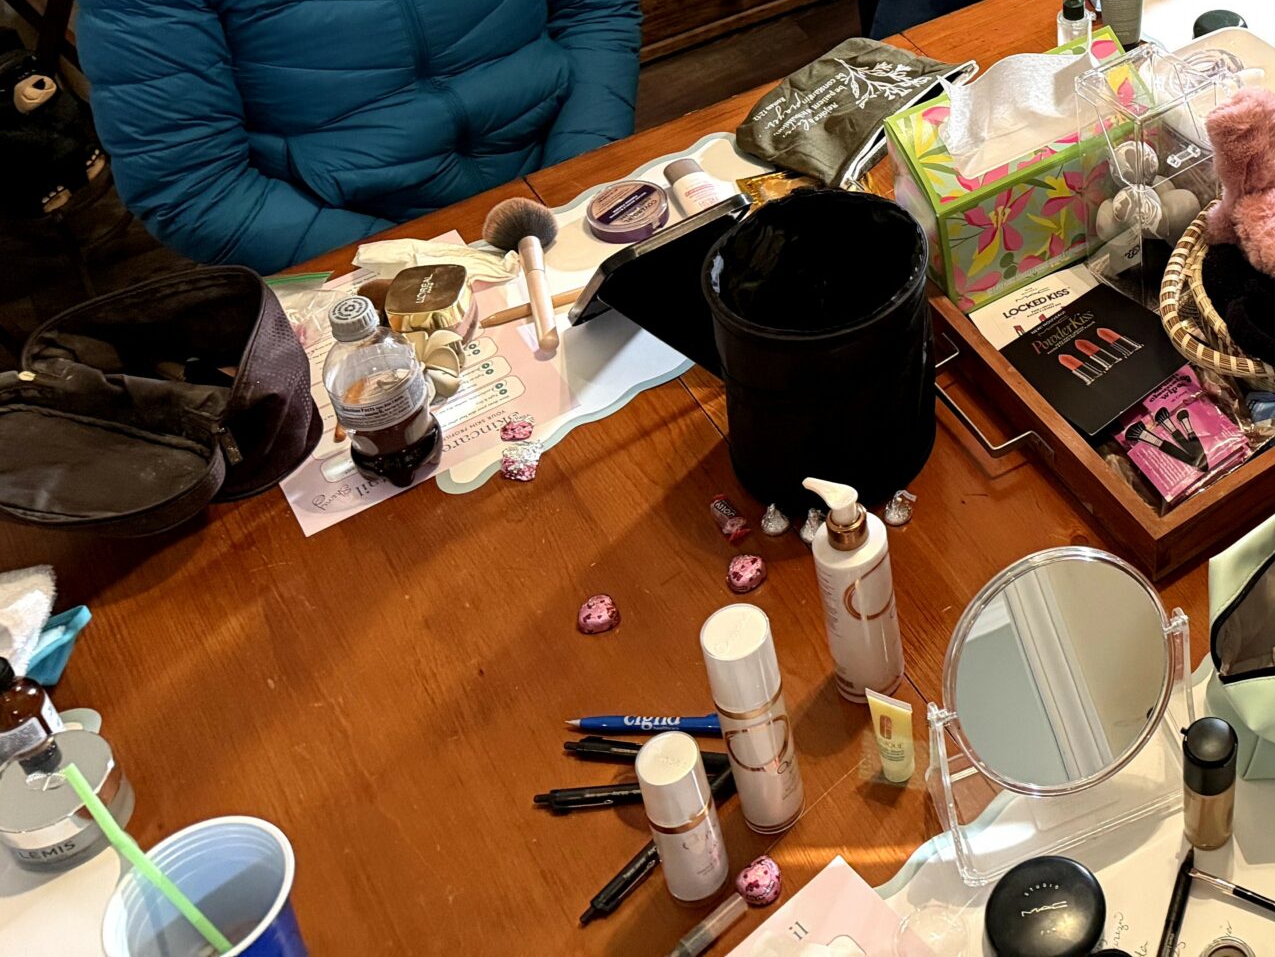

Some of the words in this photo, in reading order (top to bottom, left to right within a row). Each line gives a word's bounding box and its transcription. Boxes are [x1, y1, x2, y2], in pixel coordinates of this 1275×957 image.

[814, 102, 838, 122] Rejoice
[1003, 296, 1048, 319] LOCKED
[1047, 288, 1070, 302] KISS
[486, 409, 505, 420] YOUR
[469, 419, 486, 429] SKIN
[714, 501, 736, 518] JOLLY
[17, 840, 77, 861] LEMIS
[1024, 882, 1059, 897] STUDIO
